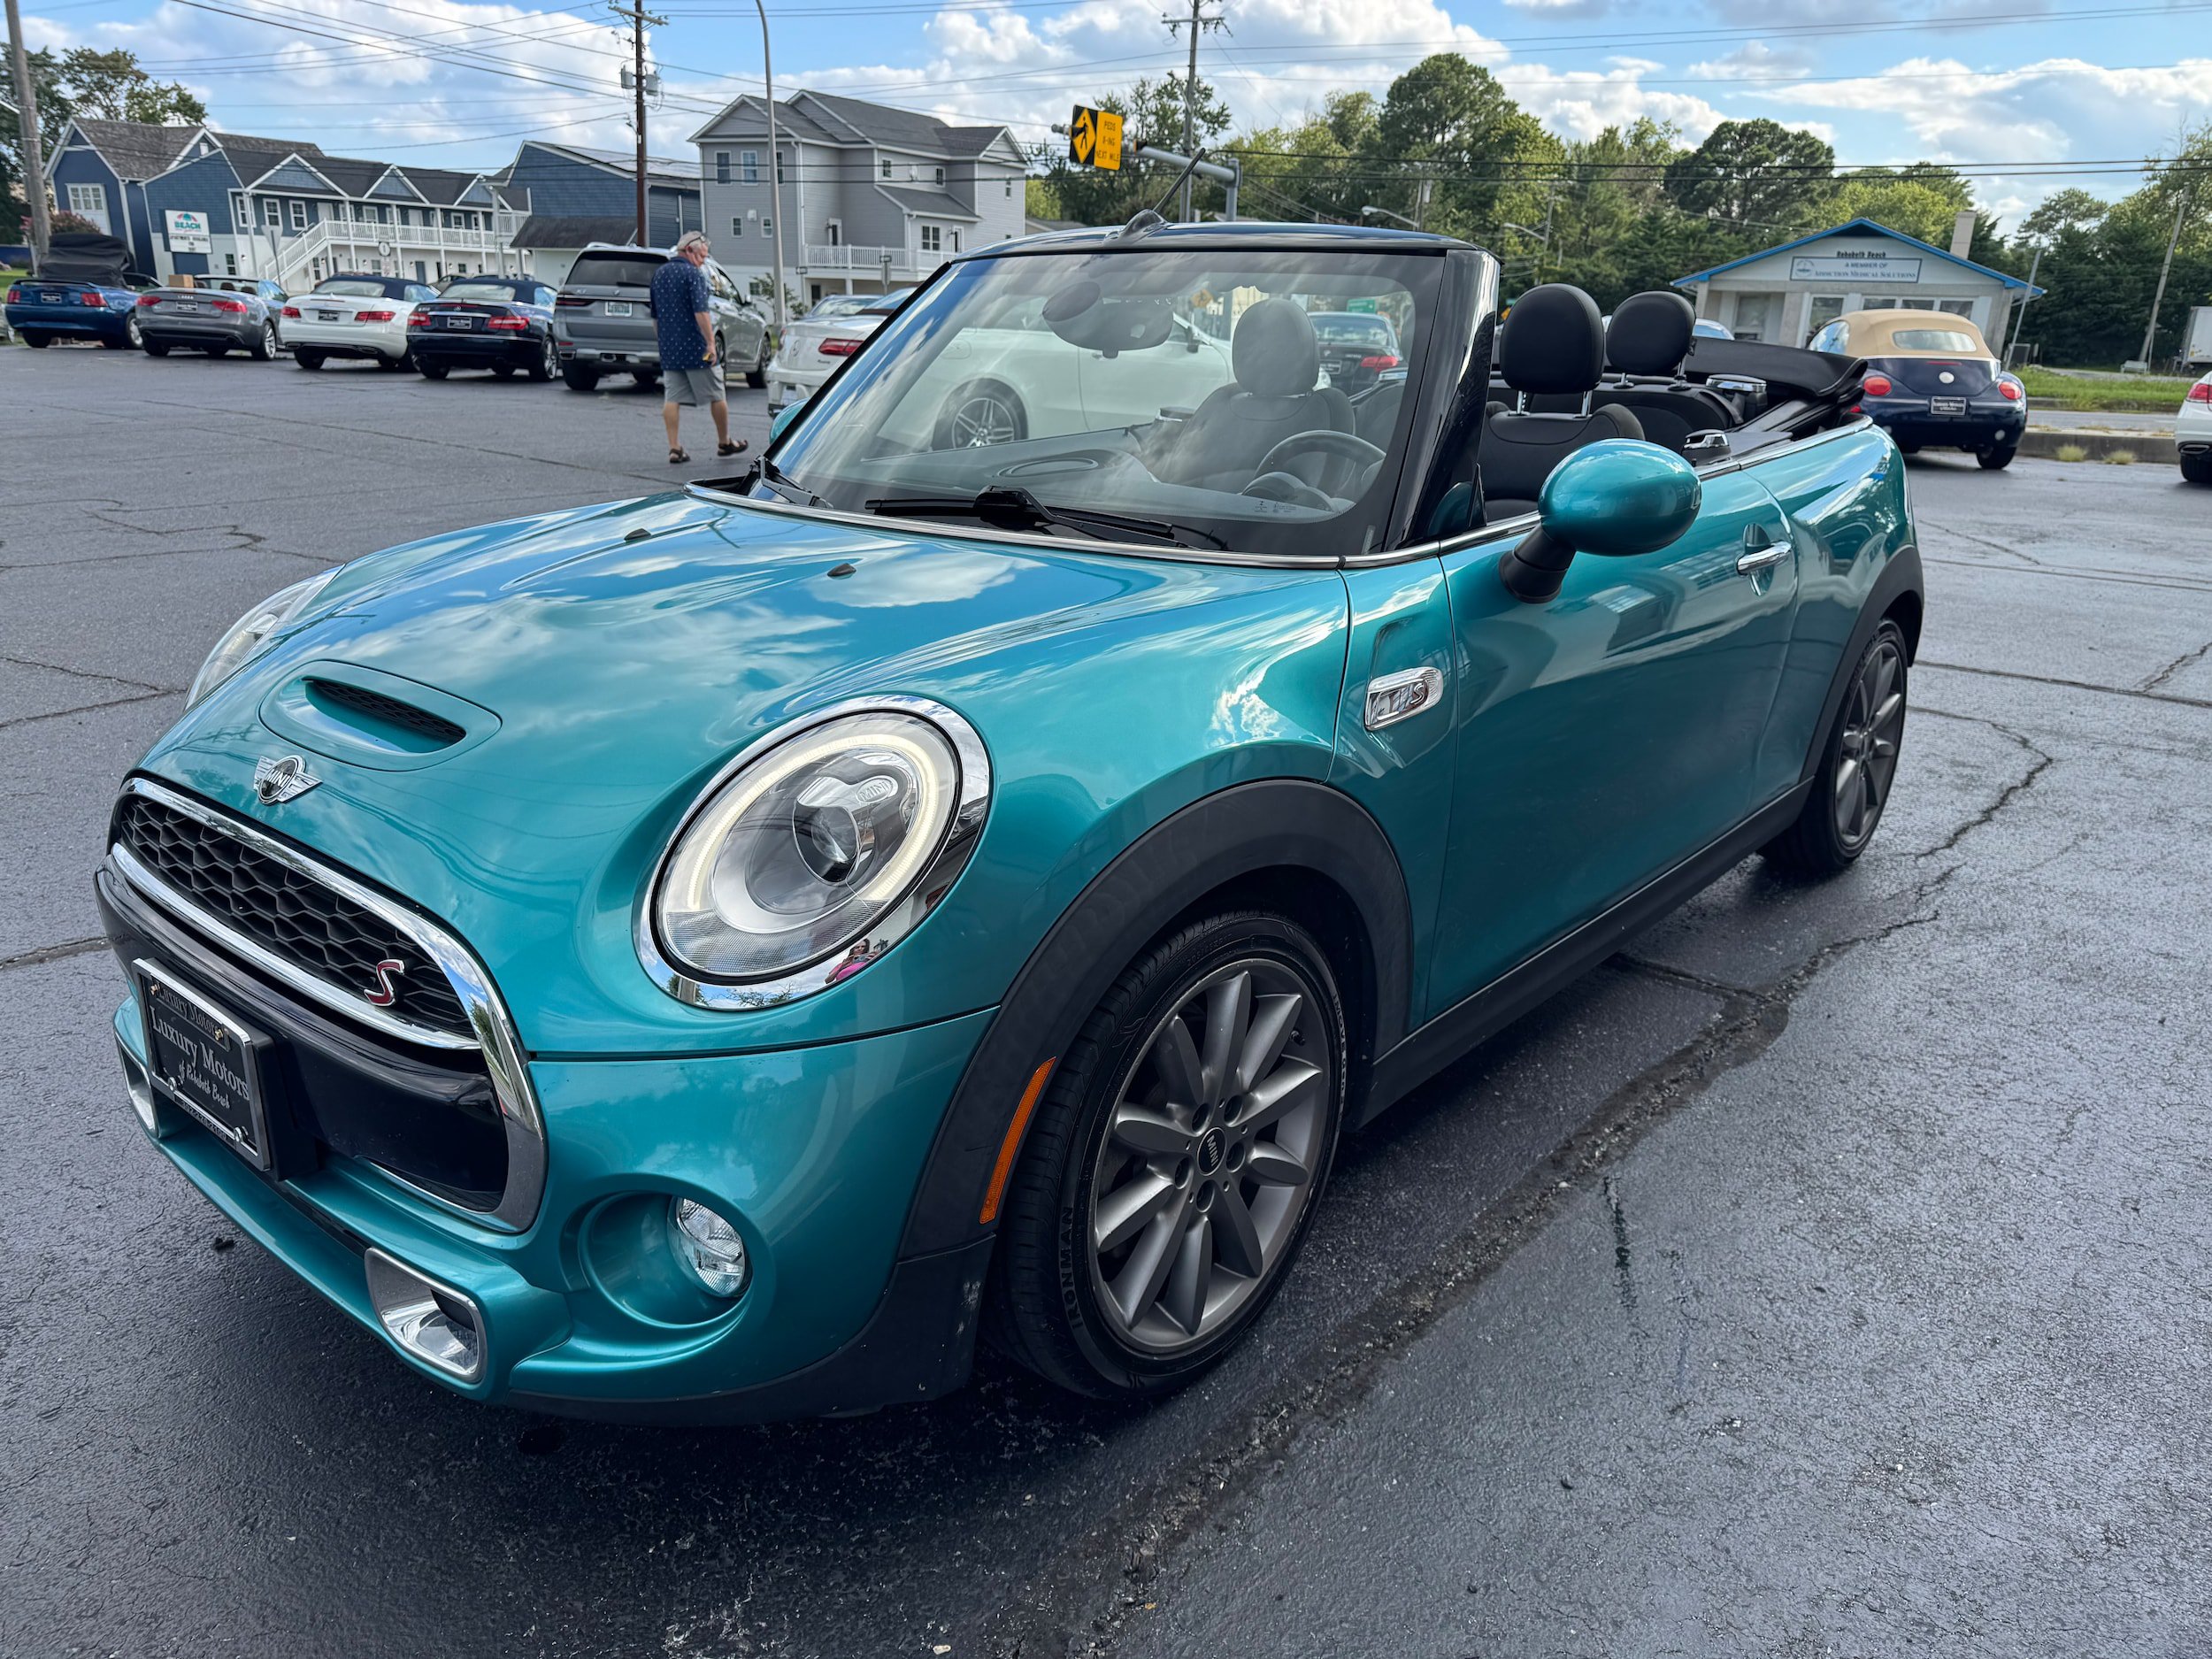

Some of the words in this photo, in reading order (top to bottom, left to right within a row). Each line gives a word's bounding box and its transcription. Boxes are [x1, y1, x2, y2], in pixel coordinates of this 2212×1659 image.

[1103, 119, 1117, 132] PEDS
[1110, 152, 1120, 162] MILE
[1409, 681, 1426, 706] S
[265, 768, 292, 789] MINI
[859, 781, 891, 801] MINI
[364, 958, 405, 1007] S
[150, 1005, 198, 1068] Luxury
[200, 1041, 250, 1101] Motors
[1206, 1134, 1219, 1167] MINI
[1059, 1206, 1085, 1329] IRONMAN
